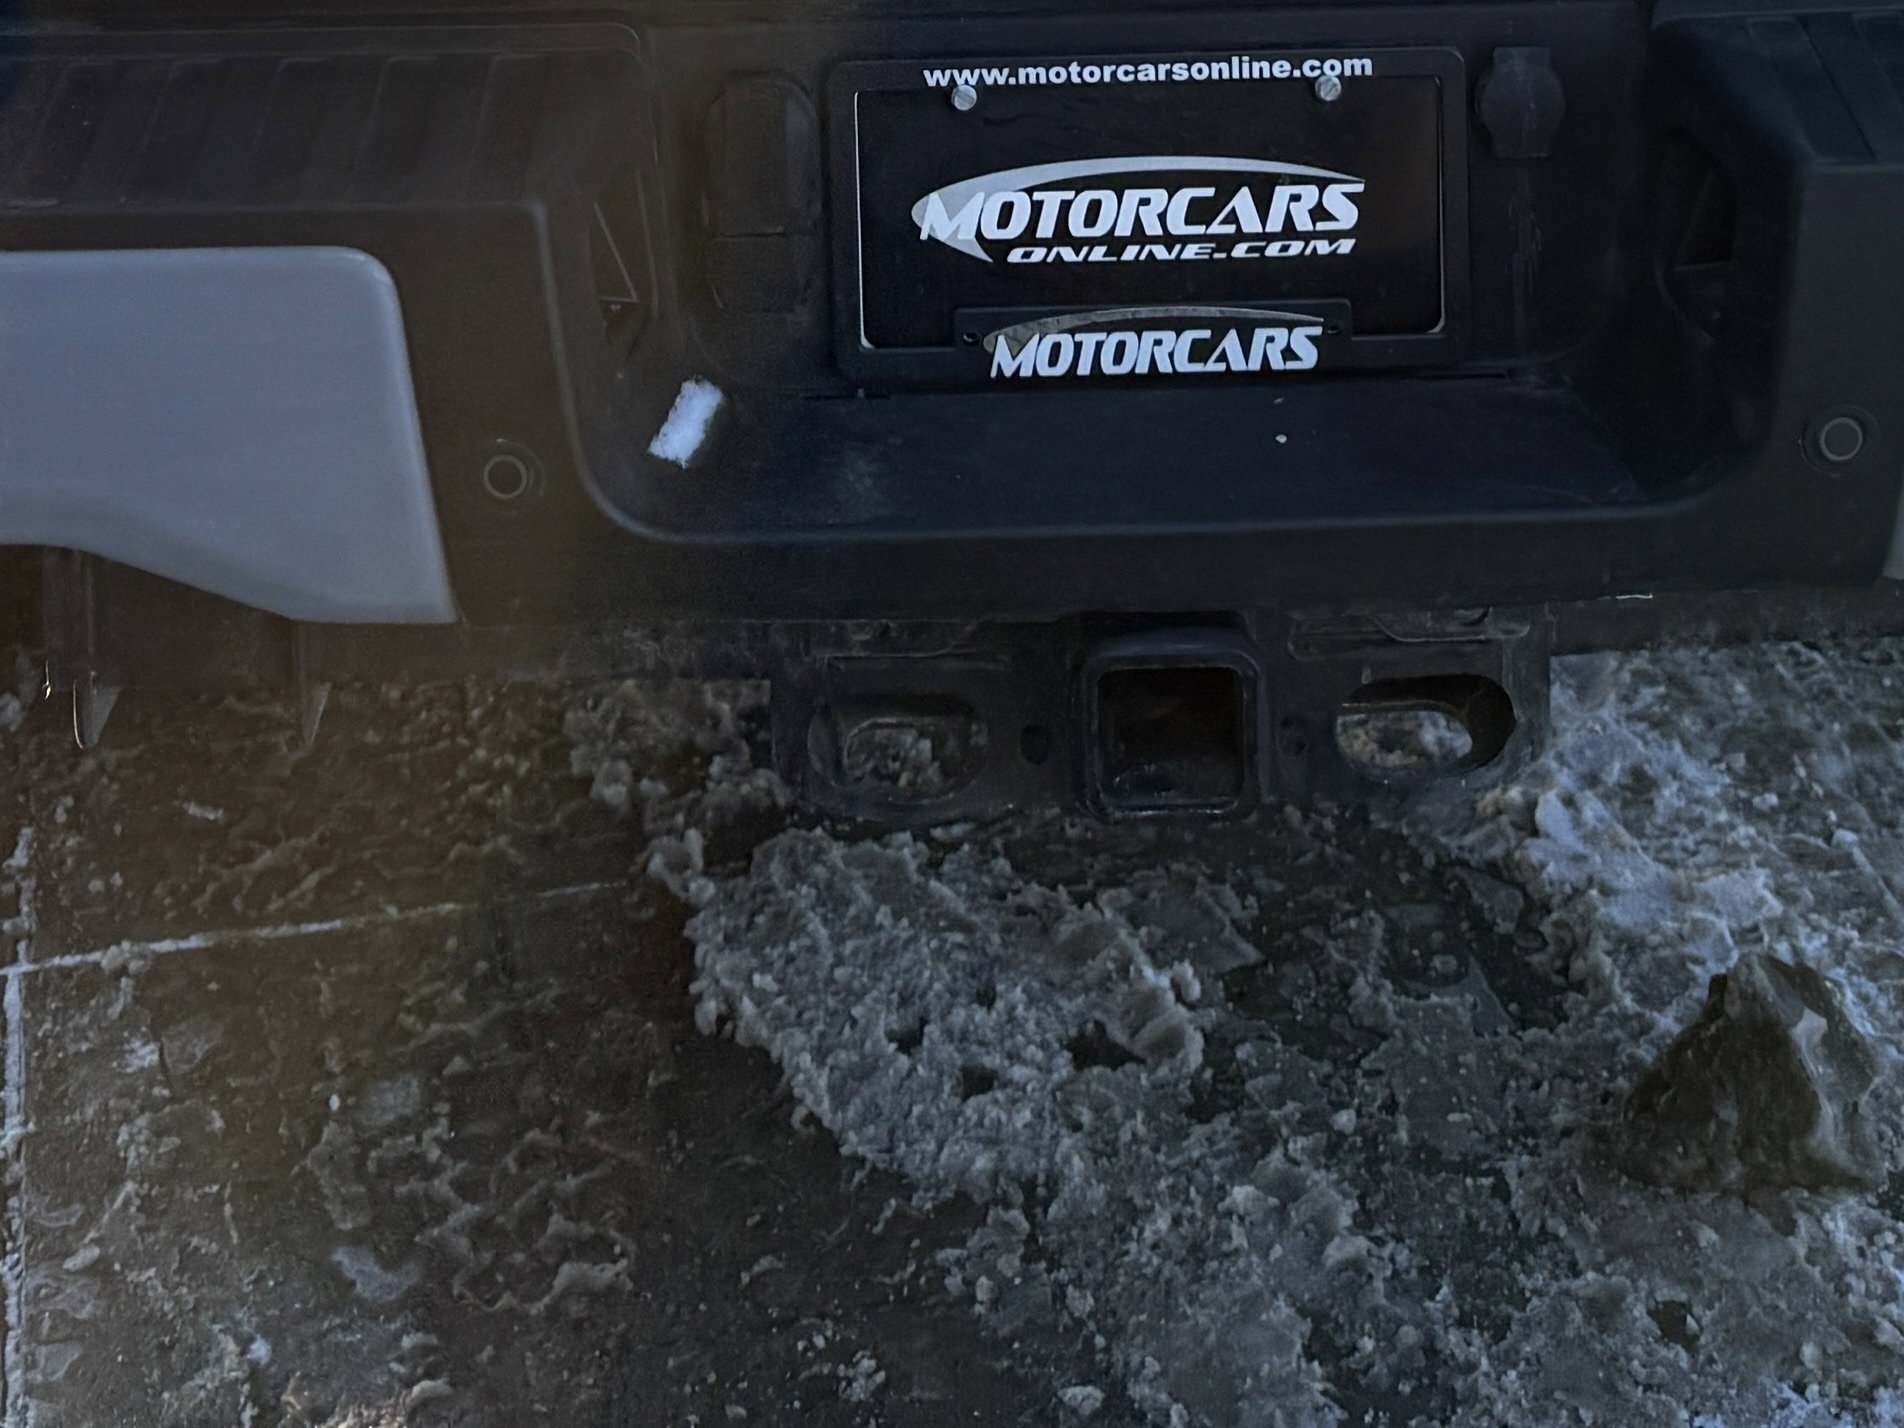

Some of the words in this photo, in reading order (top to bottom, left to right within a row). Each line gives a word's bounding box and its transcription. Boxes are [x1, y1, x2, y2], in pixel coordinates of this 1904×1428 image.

[922, 55, 1374, 87] www.motorcarsonline.com
[920, 182, 1365, 241] MOTORCARS
[1006, 238, 1357, 264] ONLINE.COM
[990, 326, 1324, 380] MOTORCARS
